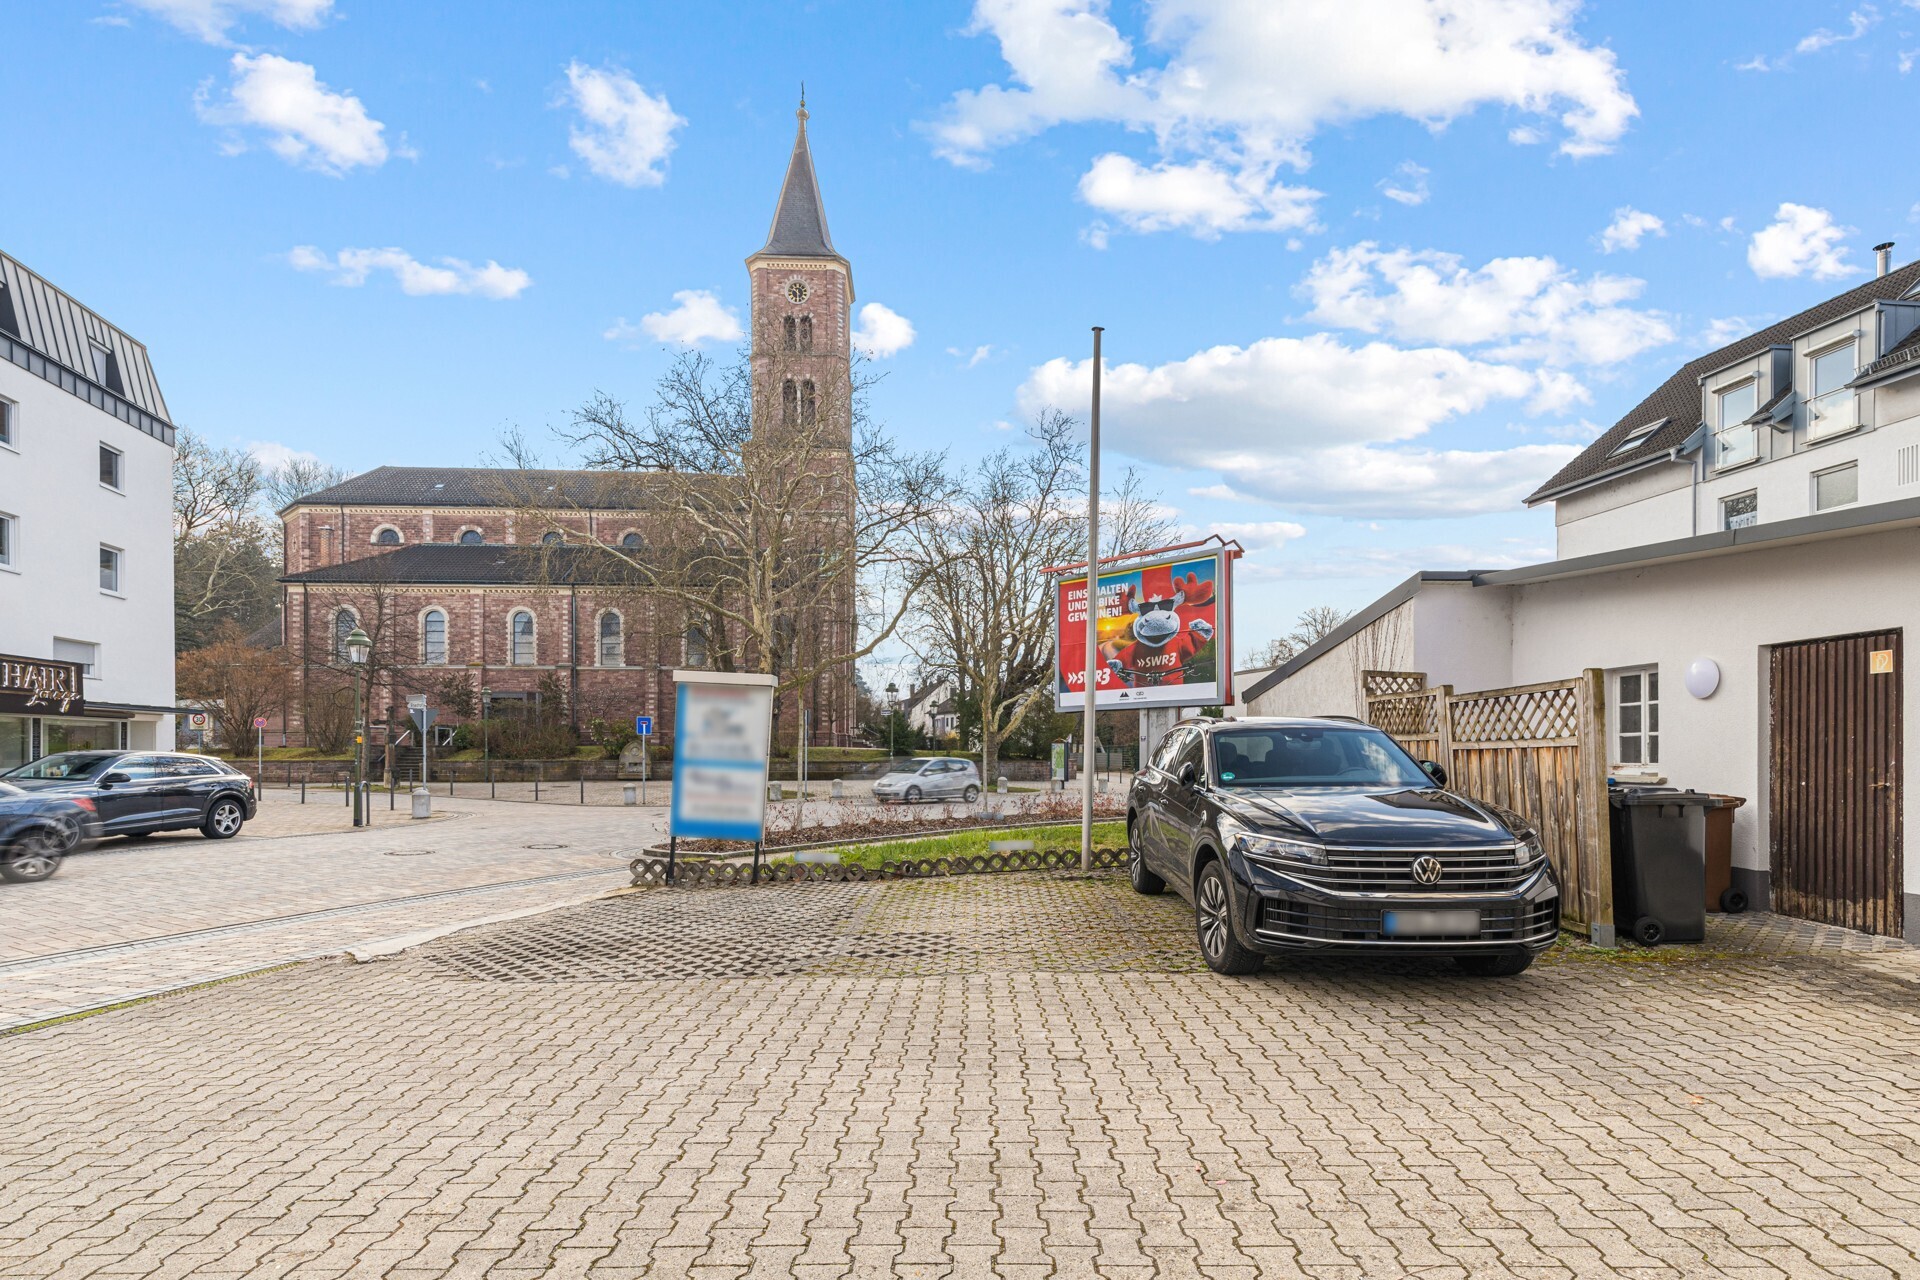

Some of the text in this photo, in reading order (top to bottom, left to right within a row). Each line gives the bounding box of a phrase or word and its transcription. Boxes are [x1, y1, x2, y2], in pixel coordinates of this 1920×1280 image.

[1068, 583, 1128, 600] EINSALTEN
[1068, 601, 1087, 611] UND
[1068, 606, 1122, 622] GEWNEN!
[2, 662, 67, 692] HAIR
[1077, 668, 1110, 685] SR3
